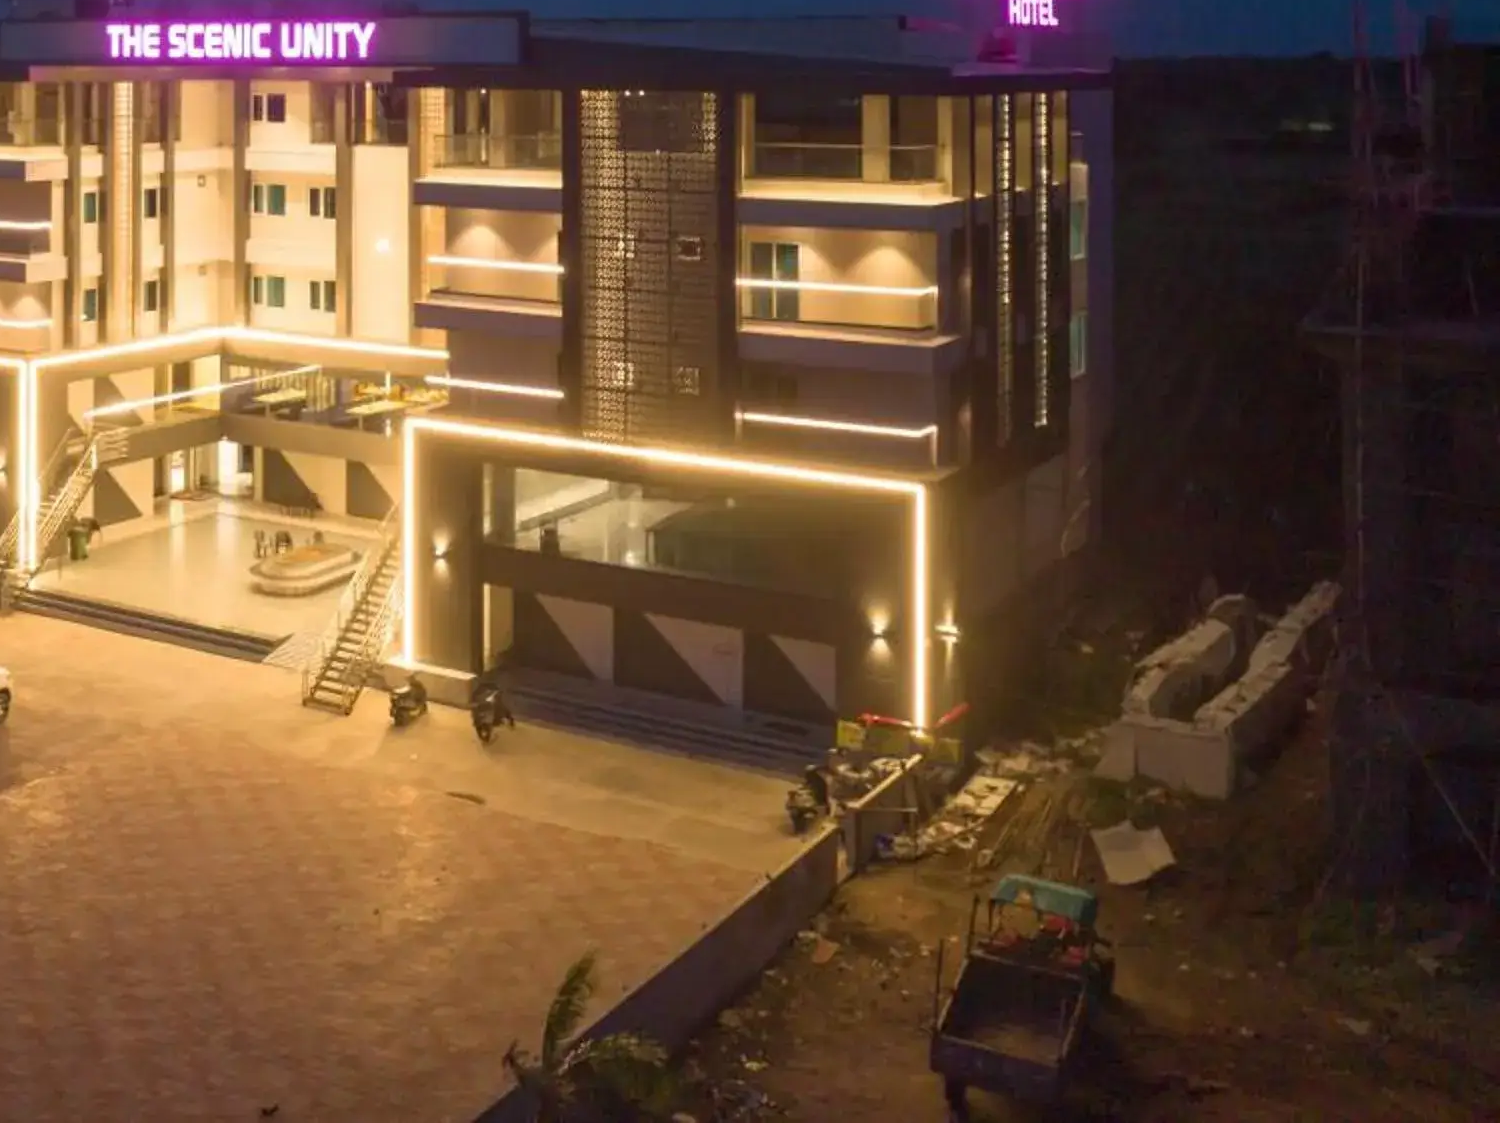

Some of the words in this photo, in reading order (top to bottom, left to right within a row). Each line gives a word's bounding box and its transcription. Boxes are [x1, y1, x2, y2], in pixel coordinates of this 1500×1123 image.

[106, 24, 160, 57] THE
[167, 23, 271, 58] SCENIC
[280, 22, 375, 58] UNITY
